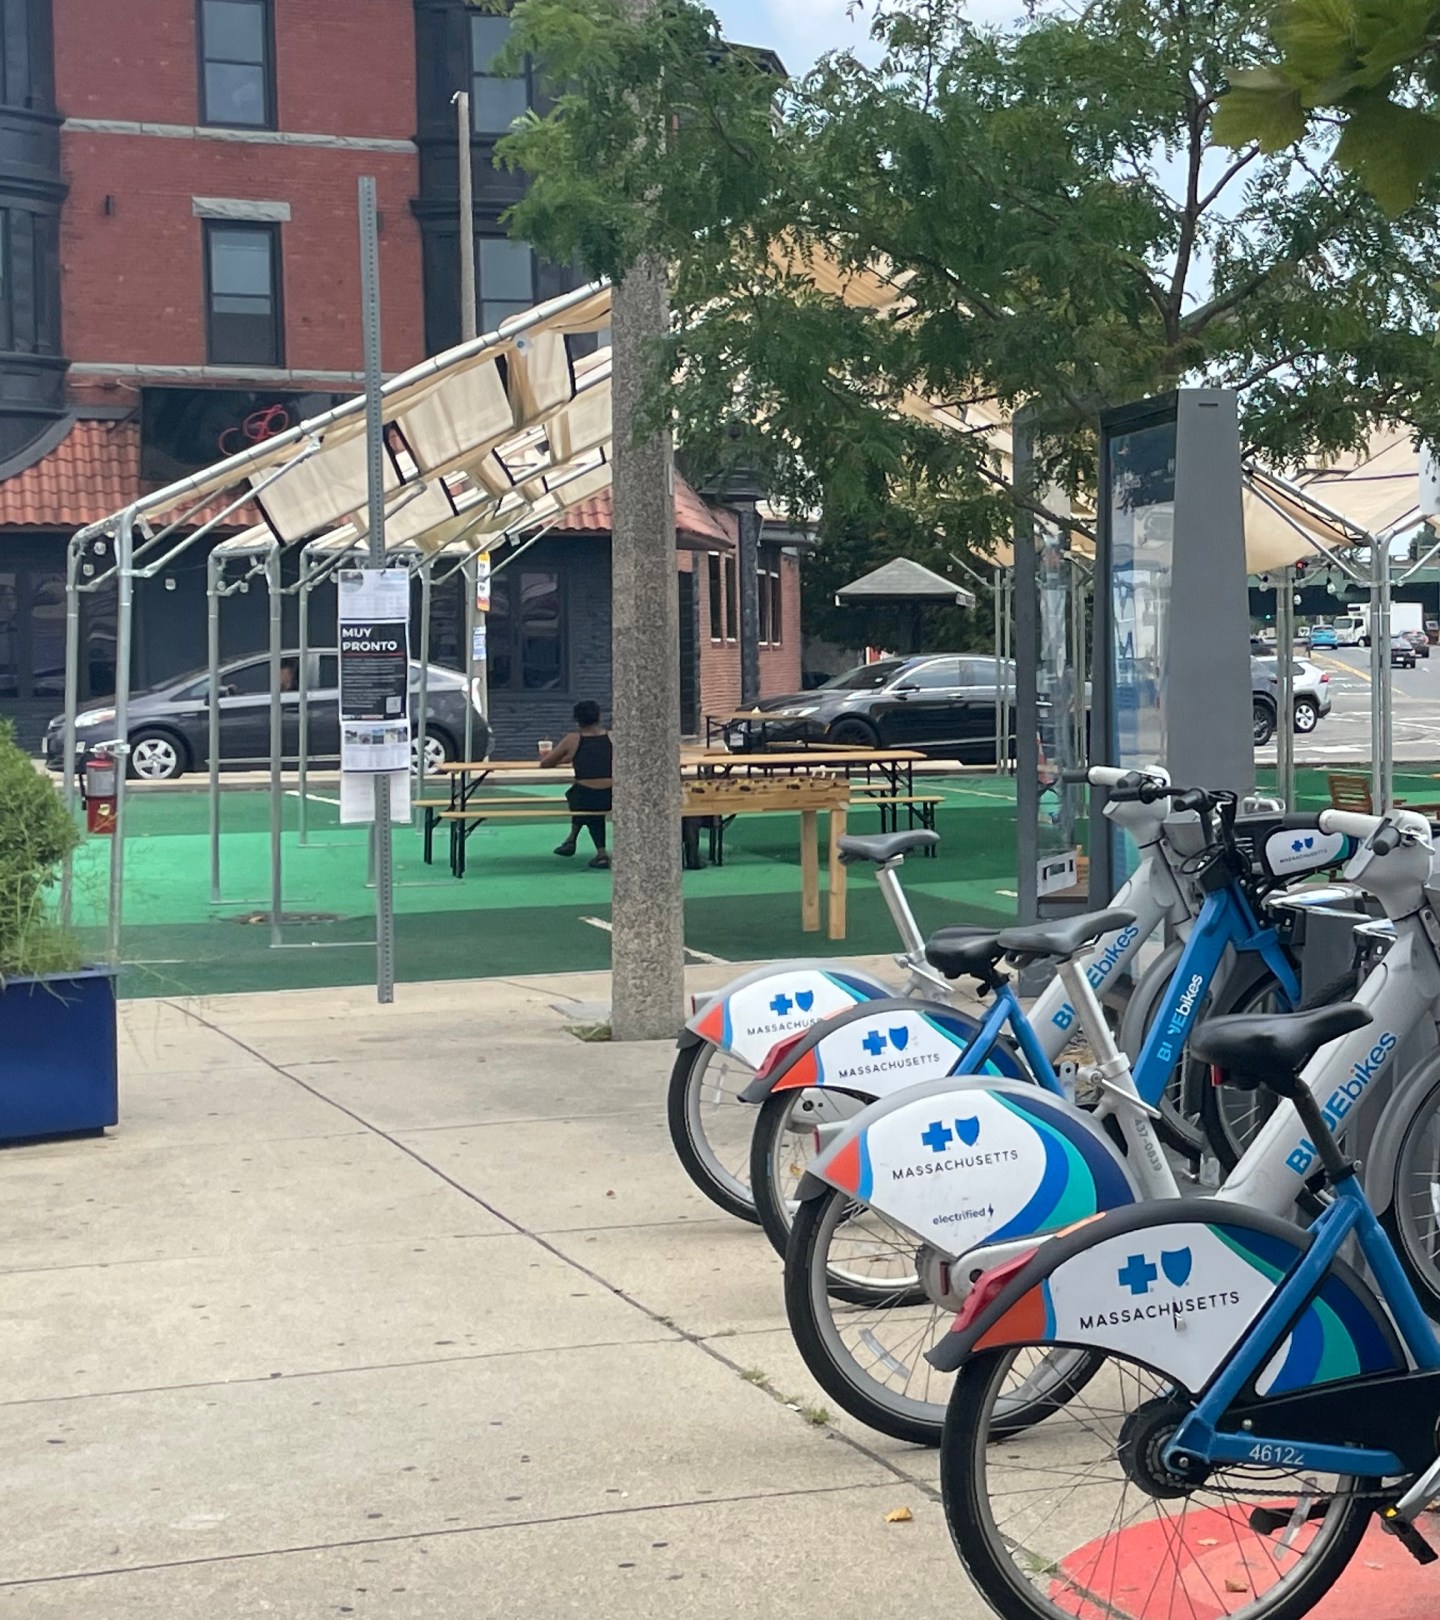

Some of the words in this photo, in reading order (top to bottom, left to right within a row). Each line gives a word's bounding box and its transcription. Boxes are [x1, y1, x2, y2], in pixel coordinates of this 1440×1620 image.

[342, 627, 372, 638] MUY
[342, 641, 398, 651] PRONTO
[1051, 925, 1139, 1031] BEbikes
[747, 1017, 823, 1036] MASSACHUS
[839, 1053, 940, 1078] MASSACHUSETTS
[1135, 1119, 1163, 1171] 437-0839
[892, 1150, 1019, 1180] MASSACHUSETTS
[932, 1207, 986, 1225] electrified
[1080, 1291, 1239, 1330] MASSACHUSETTS
